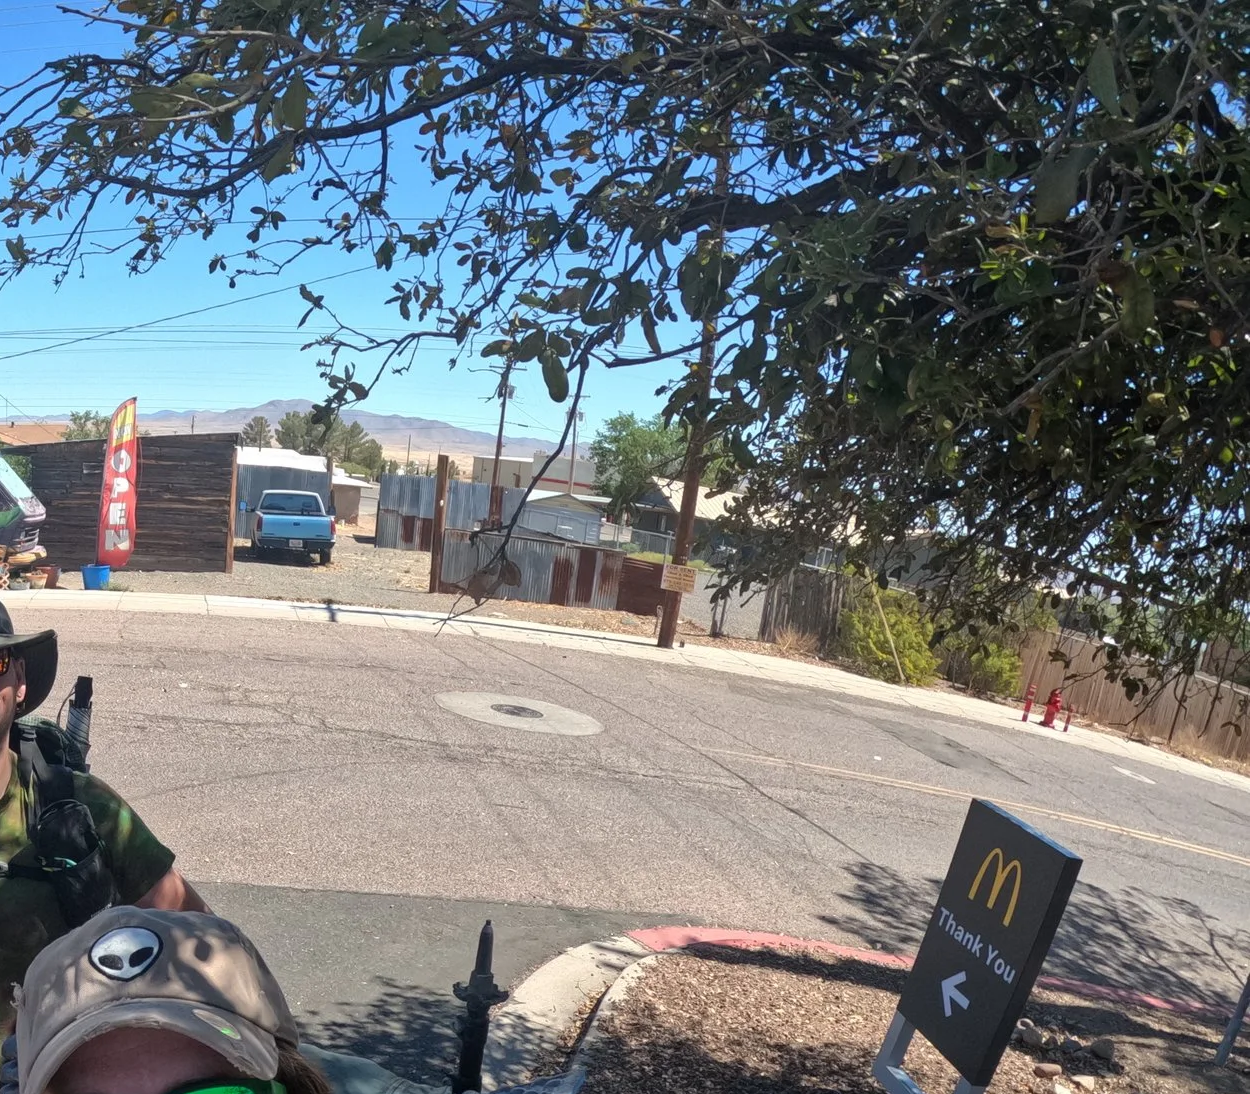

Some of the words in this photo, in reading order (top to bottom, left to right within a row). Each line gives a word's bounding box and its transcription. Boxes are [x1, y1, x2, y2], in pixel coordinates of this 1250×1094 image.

[104, 448, 132, 551] OPEN
[938, 906, 984, 958] Thank
[985, 944, 1016, 984] You
